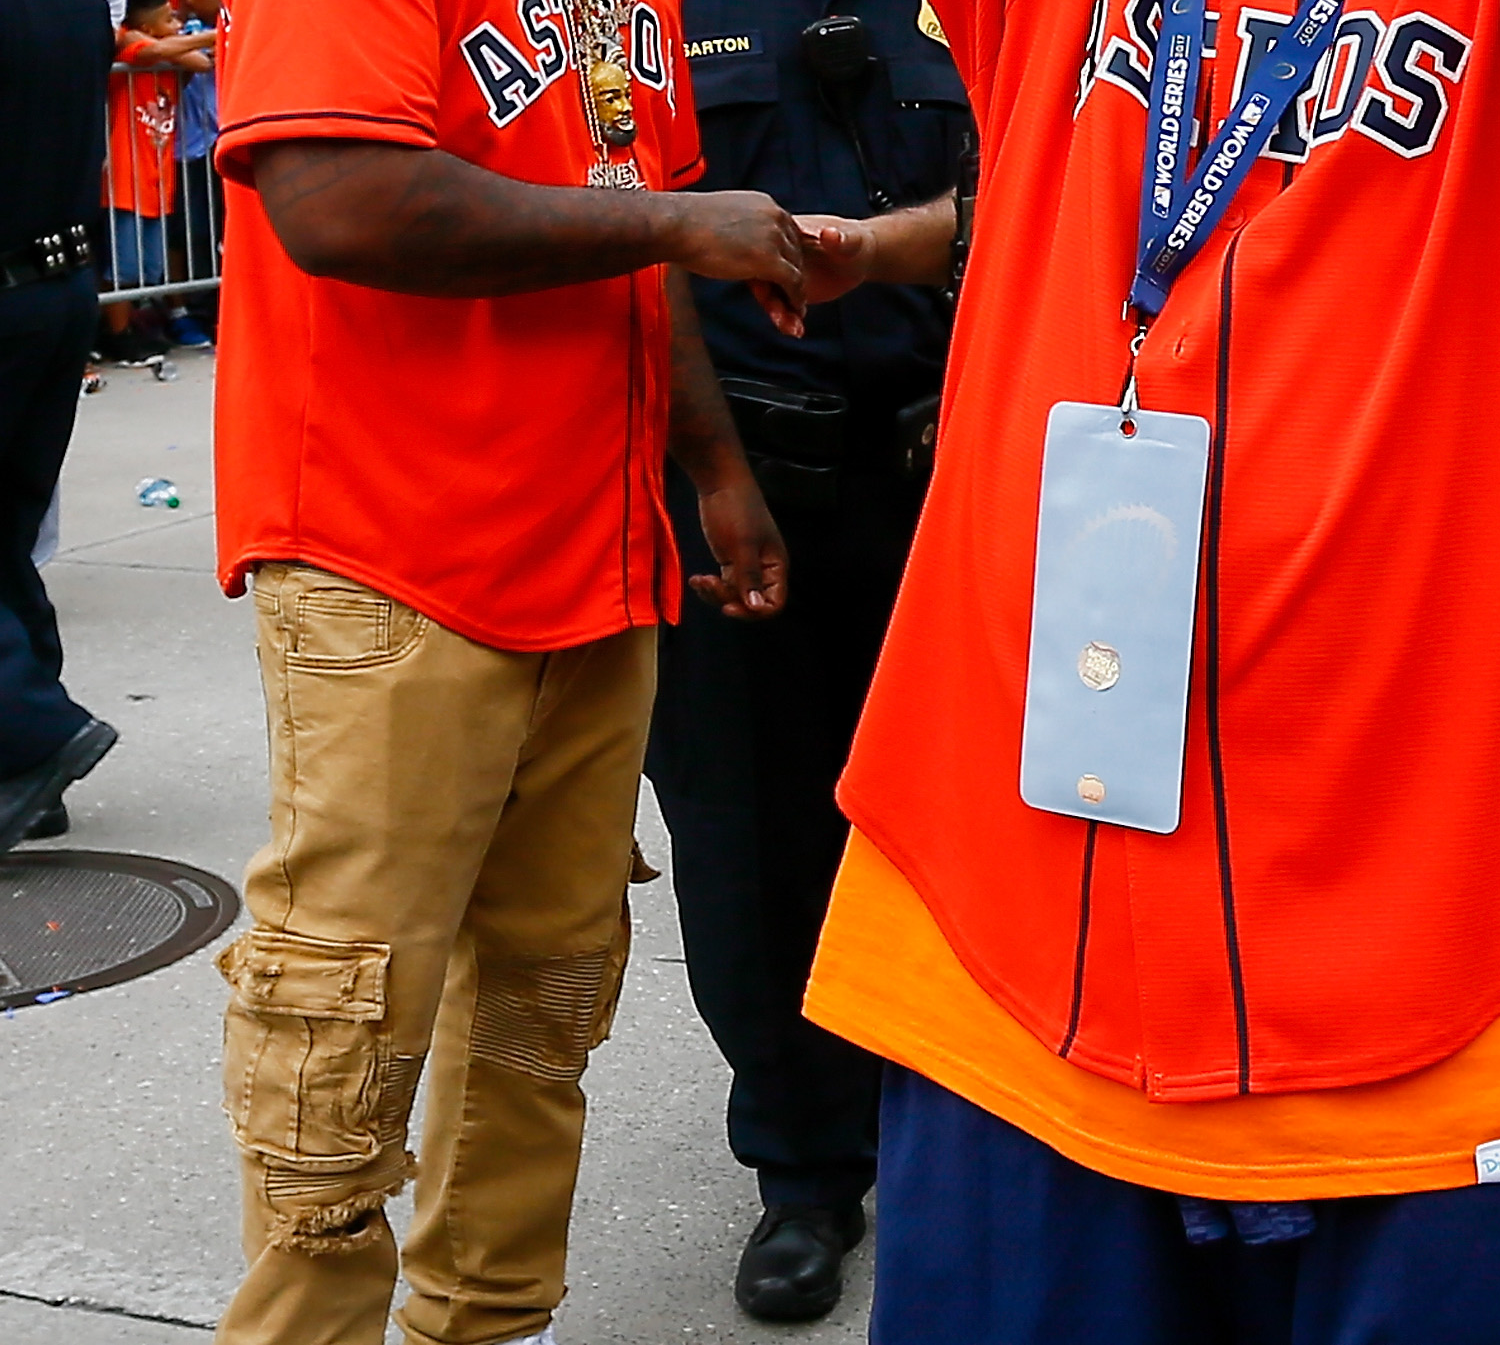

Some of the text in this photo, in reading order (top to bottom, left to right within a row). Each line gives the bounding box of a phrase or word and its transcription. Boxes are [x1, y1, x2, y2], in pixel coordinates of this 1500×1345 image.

[1154, 34, 1189, 186] WORLD SERIES 2017
[1203, 122, 1255, 193] WORLD
[1167, 188, 1215, 251] SERIES
